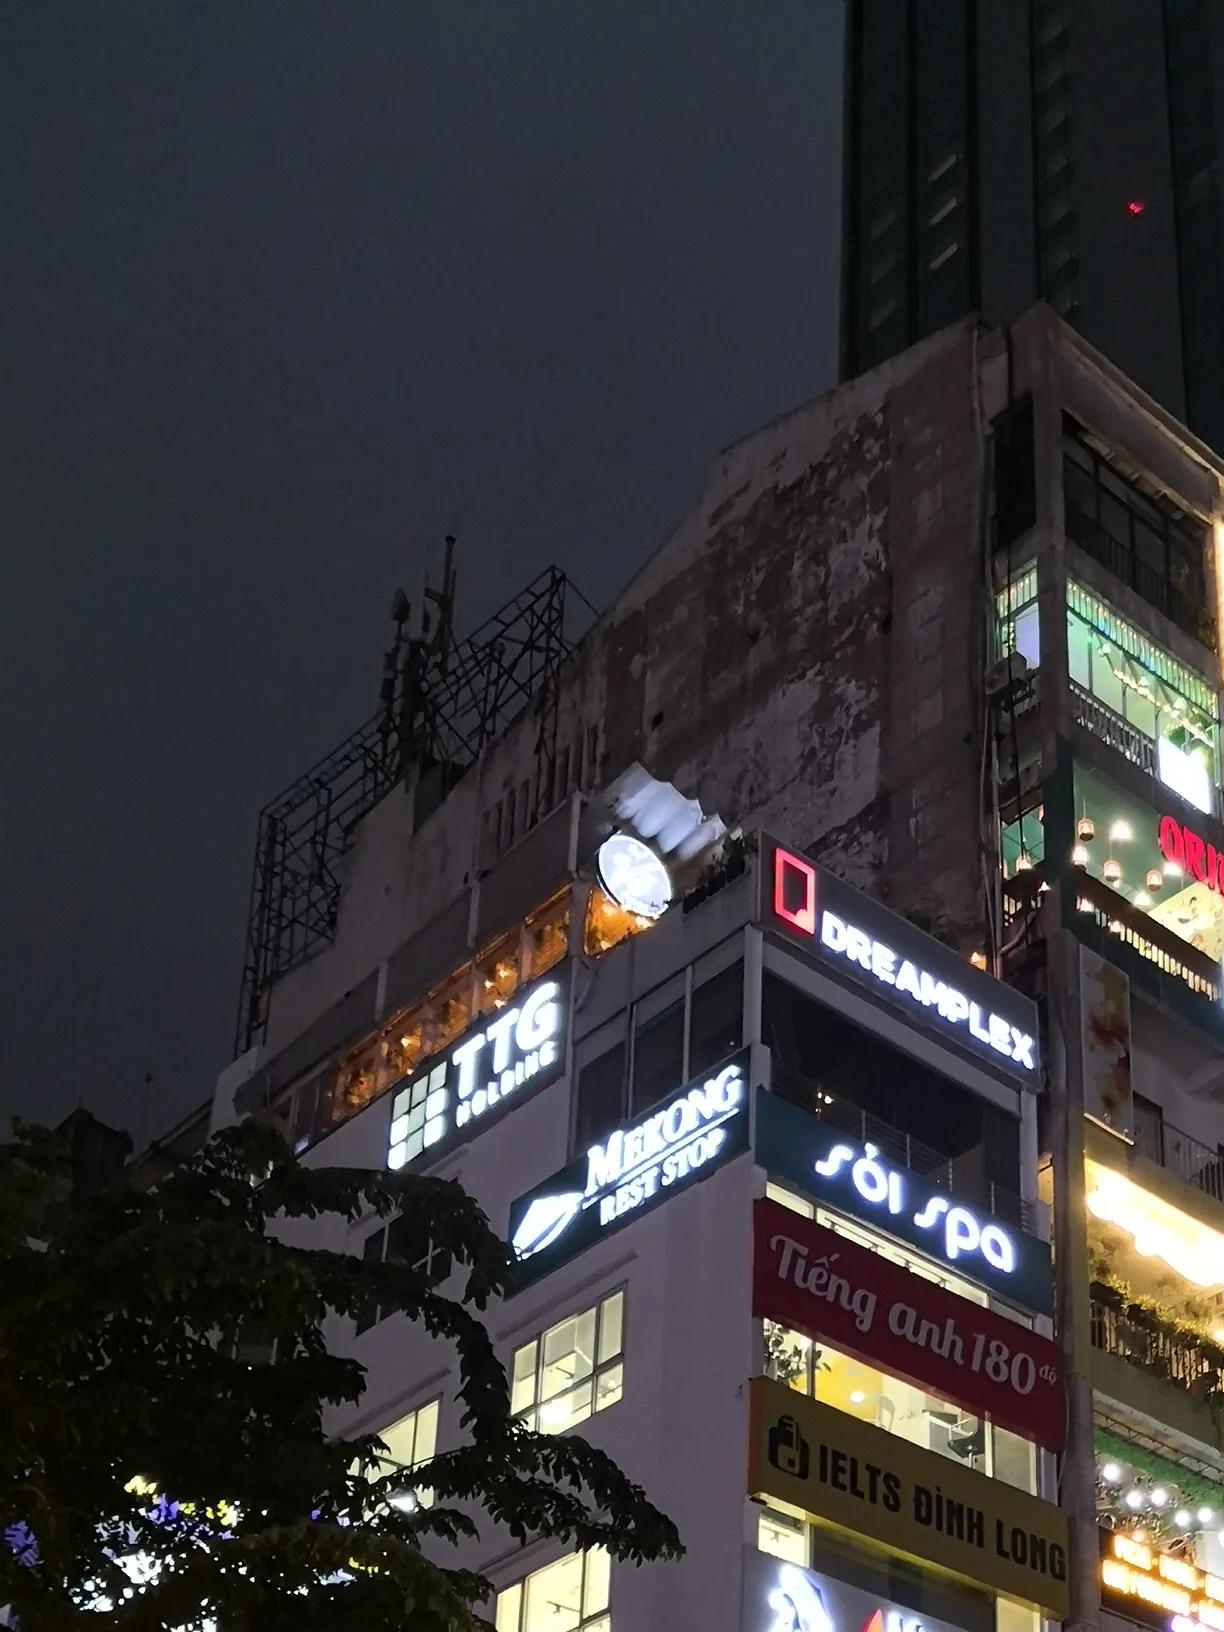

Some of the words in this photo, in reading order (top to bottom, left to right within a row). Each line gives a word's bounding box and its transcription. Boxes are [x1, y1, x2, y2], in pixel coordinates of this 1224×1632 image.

[453, 981, 560, 1099] TTG
[820, 910, 1034, 1071] DREAMPLEX
[456, 1040, 557, 1128] HOLDING
[584, 1064, 743, 1197] MEKONG
[600, 1167, 660, 1226] REST
[661, 1128, 727, 1187] STOP
[912, 1197, 1014, 1274] spa
[770, 1235, 877, 1332] Tiếng
[889, 1302, 964, 1365] anh
[971, 1333, 1036, 1395] 180
[819, 1445, 900, 1512] IELTS
[914, 1484, 984, 1548] ĐÌNH
[996, 1520, 1066, 1581] LONG
